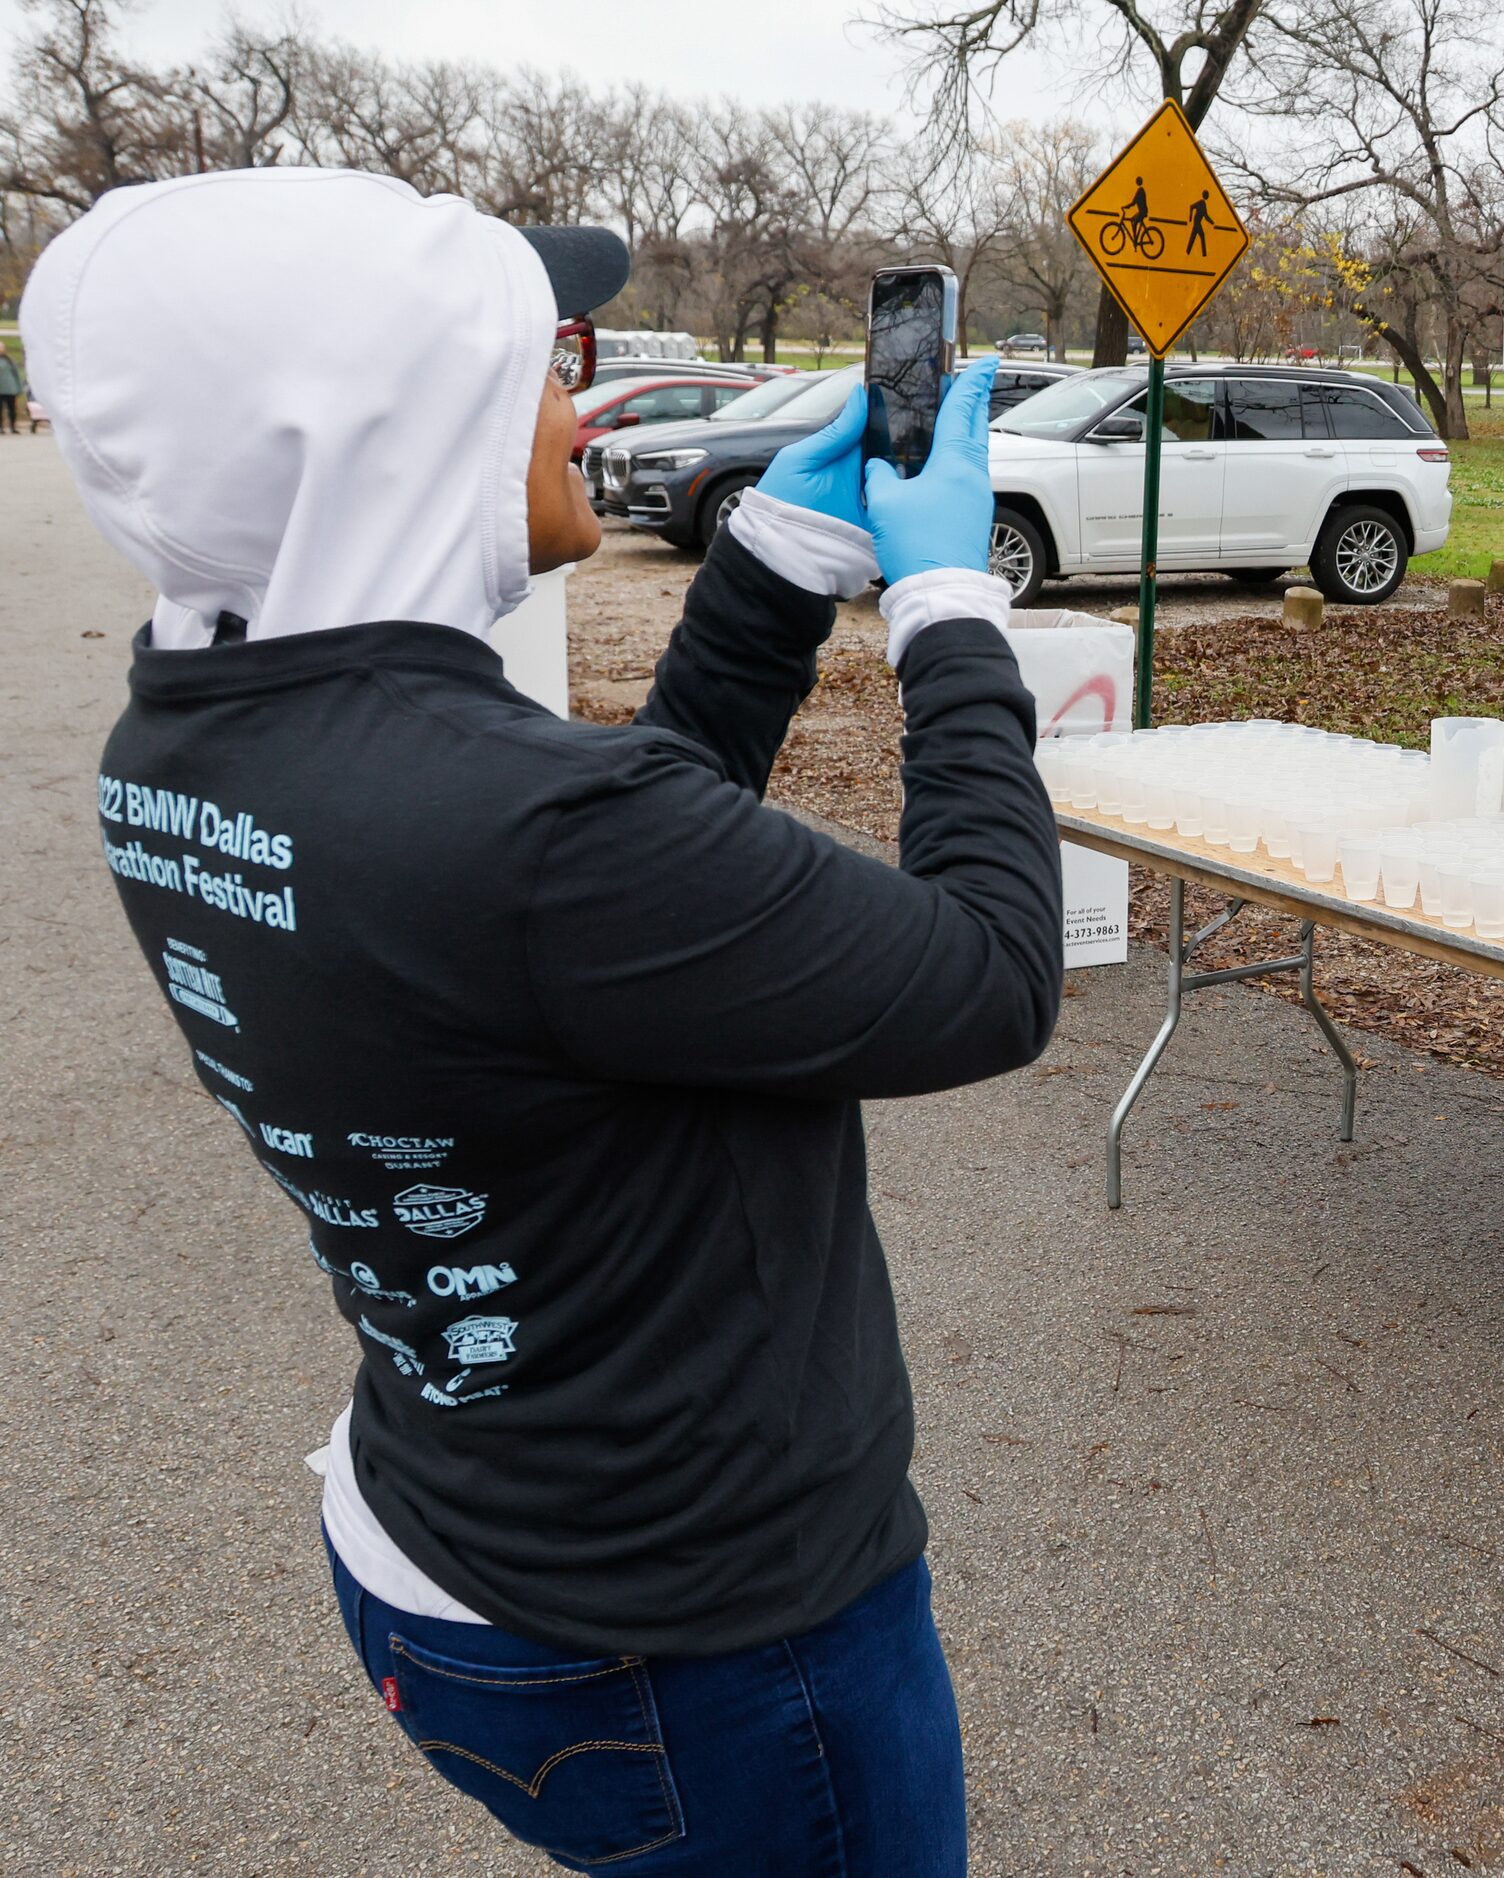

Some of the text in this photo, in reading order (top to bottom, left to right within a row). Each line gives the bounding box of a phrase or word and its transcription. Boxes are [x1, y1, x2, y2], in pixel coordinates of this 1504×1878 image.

[125, 782, 199, 840] BMW
[200, 801, 293, 870] Dallas
[183, 854, 296, 932] Festival
[1065, 925, 1119, 939] 4-373-9863
[260, 1123, 314, 1158] ucan
[348, 1133, 454, 1147] CHOCTAW
[385, 1161, 441, 1170] DURANT
[393, 1197, 487, 1222] DALLAS
